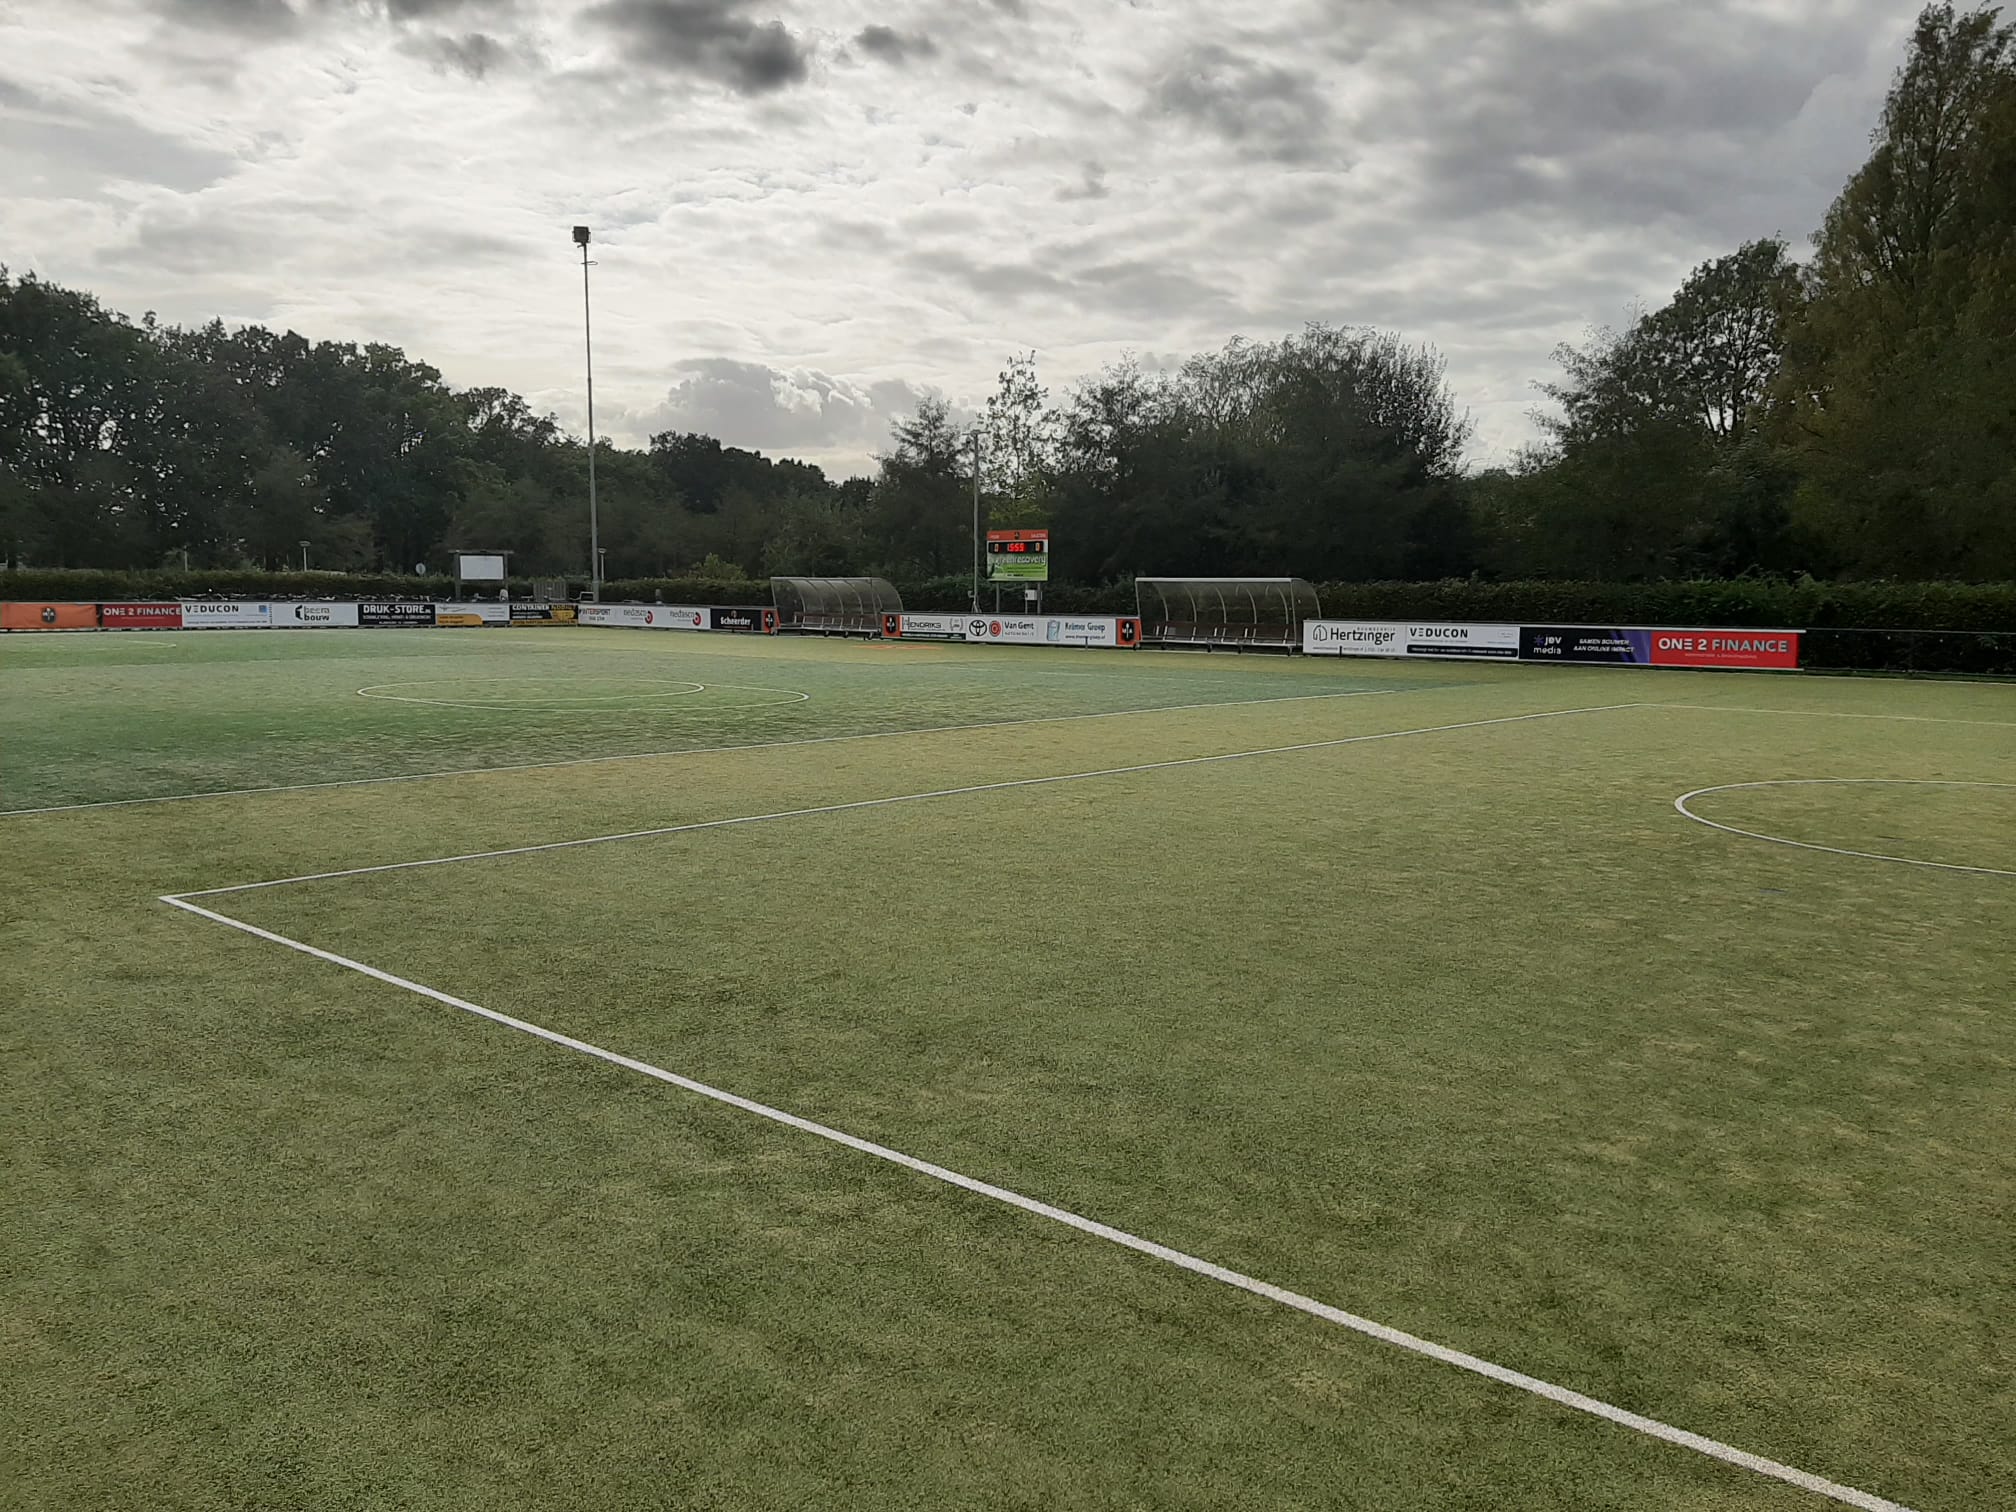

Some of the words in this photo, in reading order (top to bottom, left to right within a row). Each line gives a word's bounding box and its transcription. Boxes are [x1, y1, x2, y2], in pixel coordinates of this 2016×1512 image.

[104, 607, 126, 616] ONE
[128, 607, 135, 616] 2
[137, 607, 182, 616] FINANCE
[185, 605, 239, 613] VEDUCON
[1004, 621, 1017, 630] Van
[1018, 621, 1034, 630] Gent
[1330, 626, 1396, 646] Hertzinger
[1409, 627, 1469, 639] VEDUCON
[1657, 637, 1693, 651] ONE
[1697, 638, 1709, 651] 2
[1712, 638, 1788, 653] FINANCE
[1533, 646, 1562, 655] media
